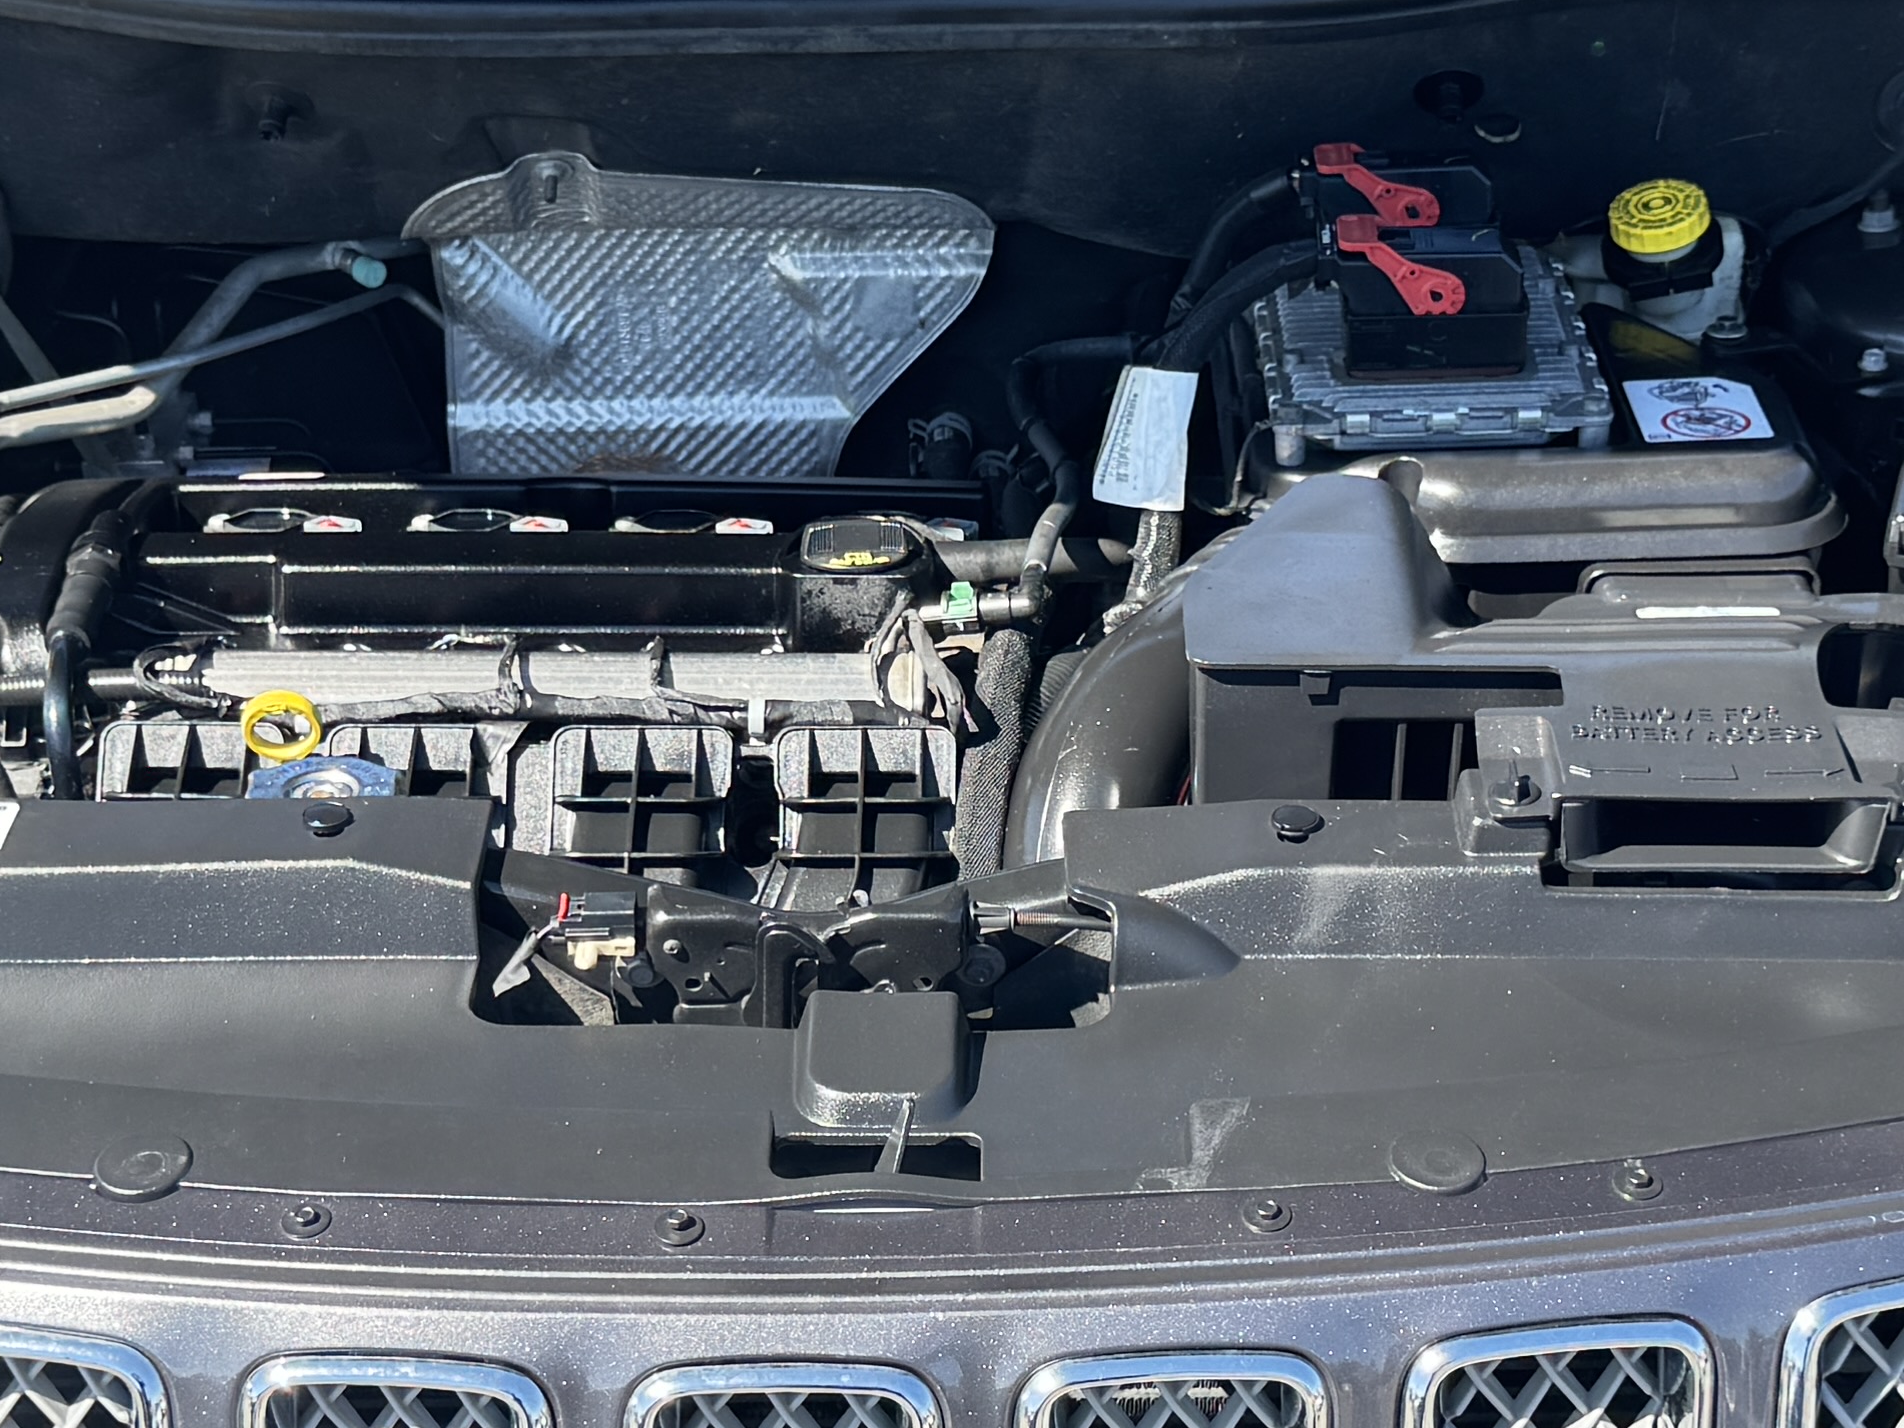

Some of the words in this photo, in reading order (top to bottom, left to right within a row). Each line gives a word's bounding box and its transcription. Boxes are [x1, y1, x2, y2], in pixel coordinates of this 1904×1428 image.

[1590, 704, 1714, 724] REMOVE
[1722, 705, 1781, 724] FOR
[1571, 724, 1694, 743] BATTERY
